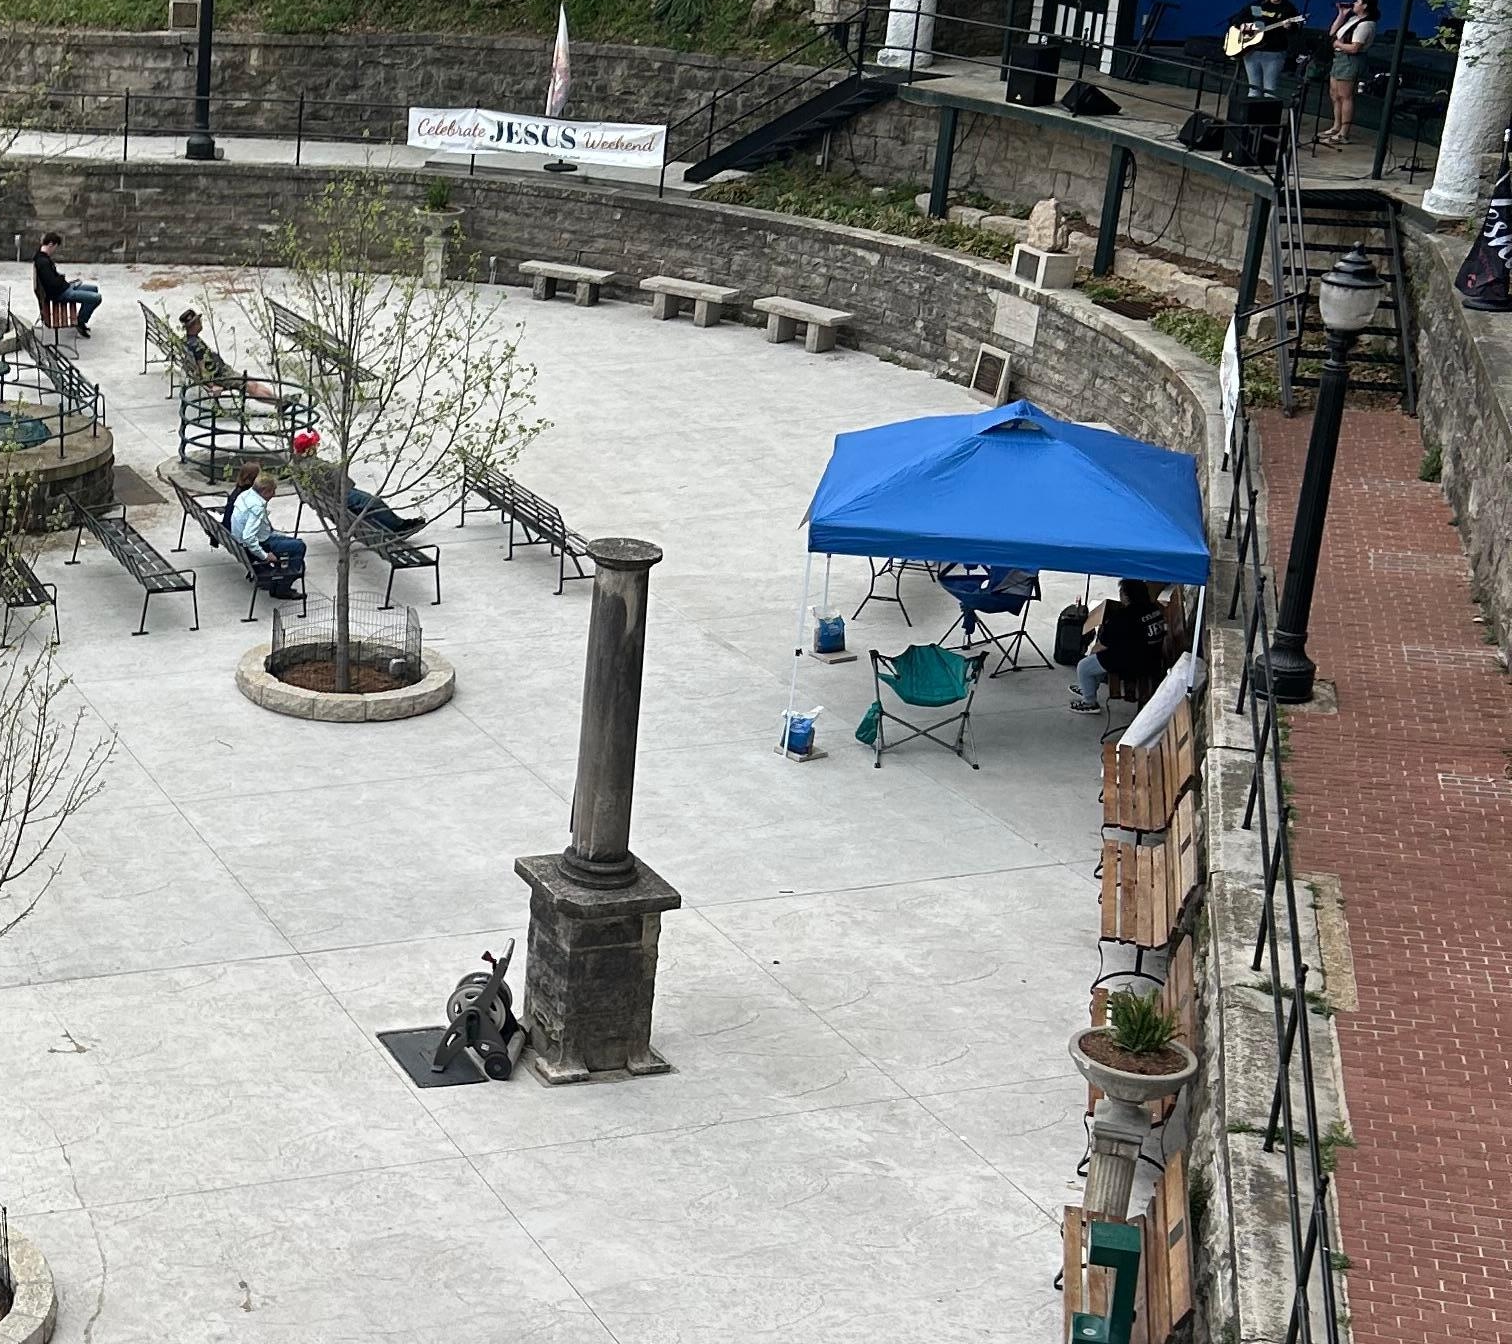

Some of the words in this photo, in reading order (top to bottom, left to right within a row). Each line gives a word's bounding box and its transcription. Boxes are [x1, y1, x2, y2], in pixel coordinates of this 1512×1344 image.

[417, 117, 486, 138] Celebrate
[489, 119, 577, 150] JESUS
[583, 131, 656, 153] Weekend
